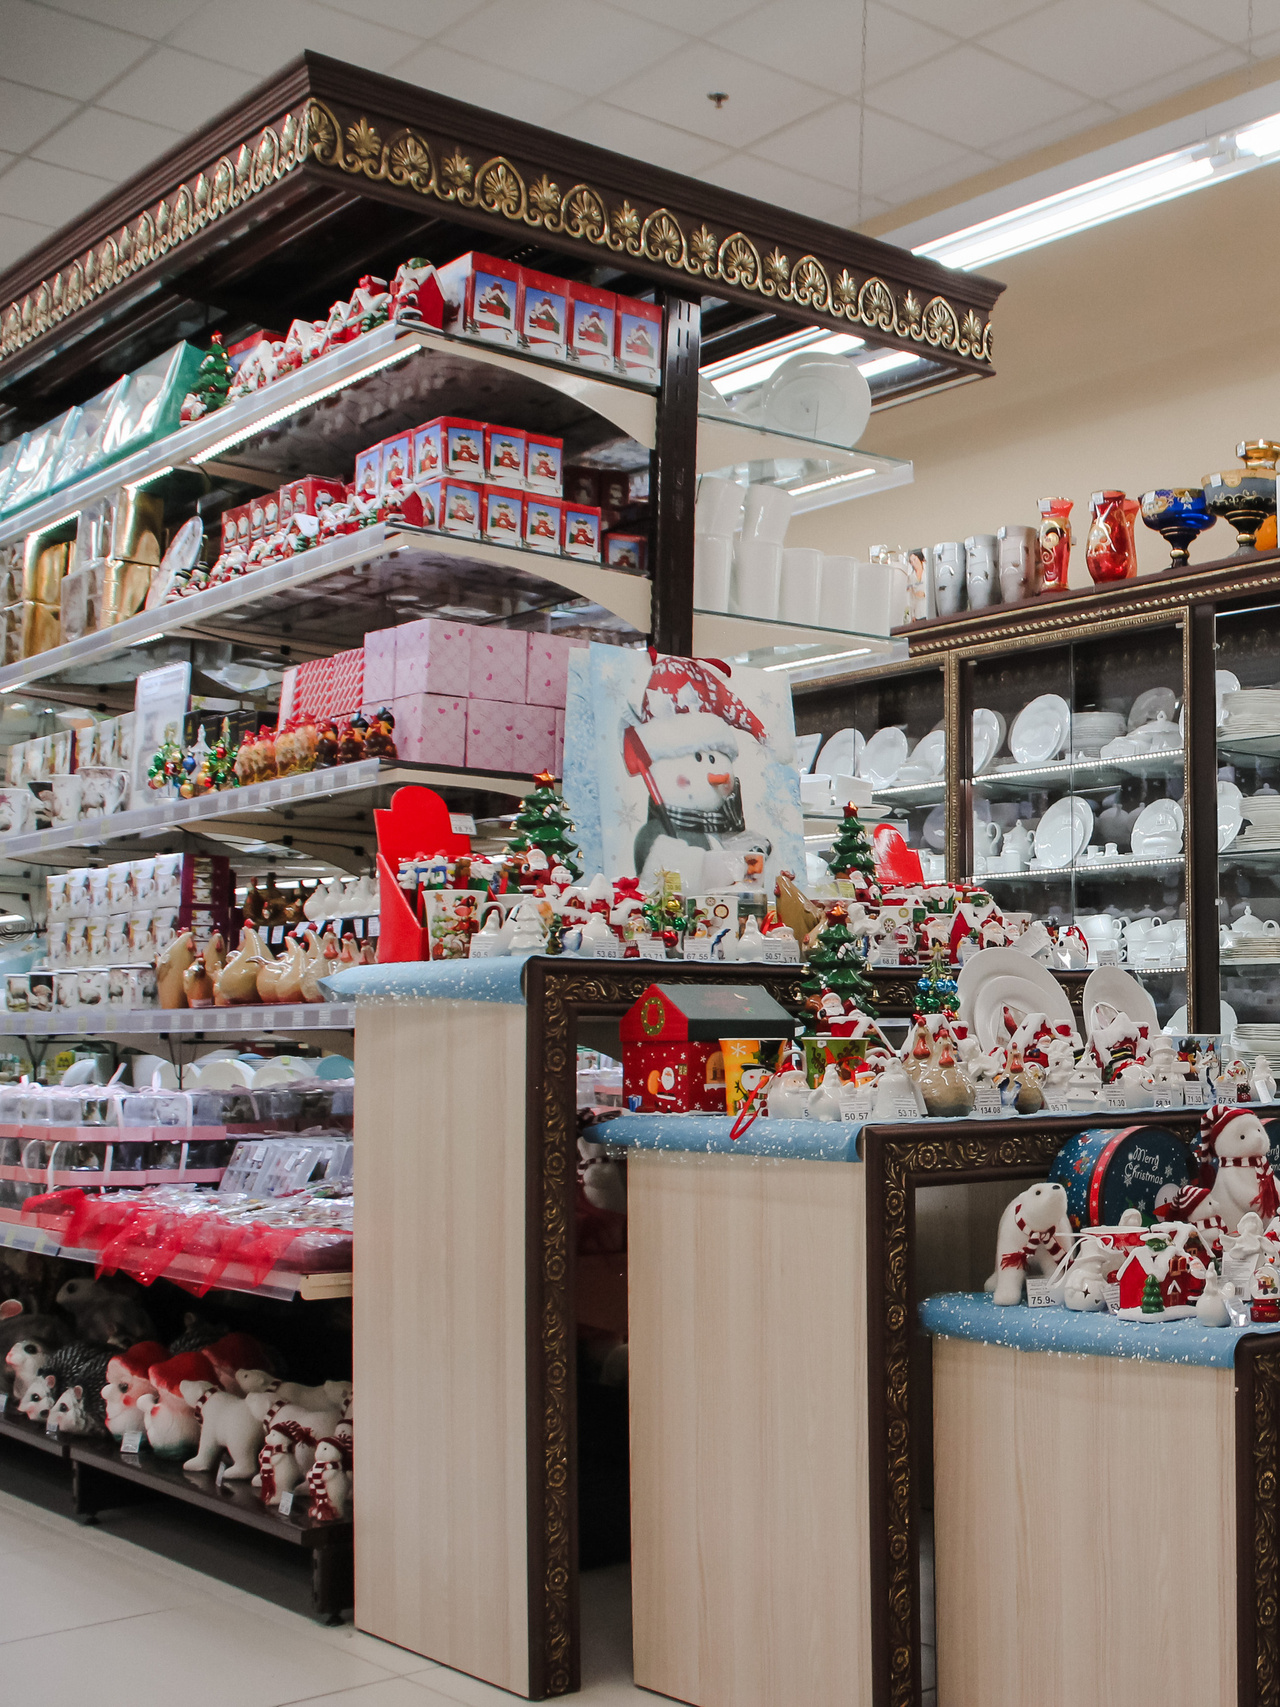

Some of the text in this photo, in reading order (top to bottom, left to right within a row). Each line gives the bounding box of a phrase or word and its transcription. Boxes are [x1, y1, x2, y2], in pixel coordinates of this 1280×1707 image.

[844, 1112, 869, 1120] 50.57
[898, 1109, 918, 1117] 53.75
[1132, 1145, 1159, 1171] Merry
[1124, 1161, 1163, 1185] Christmas
